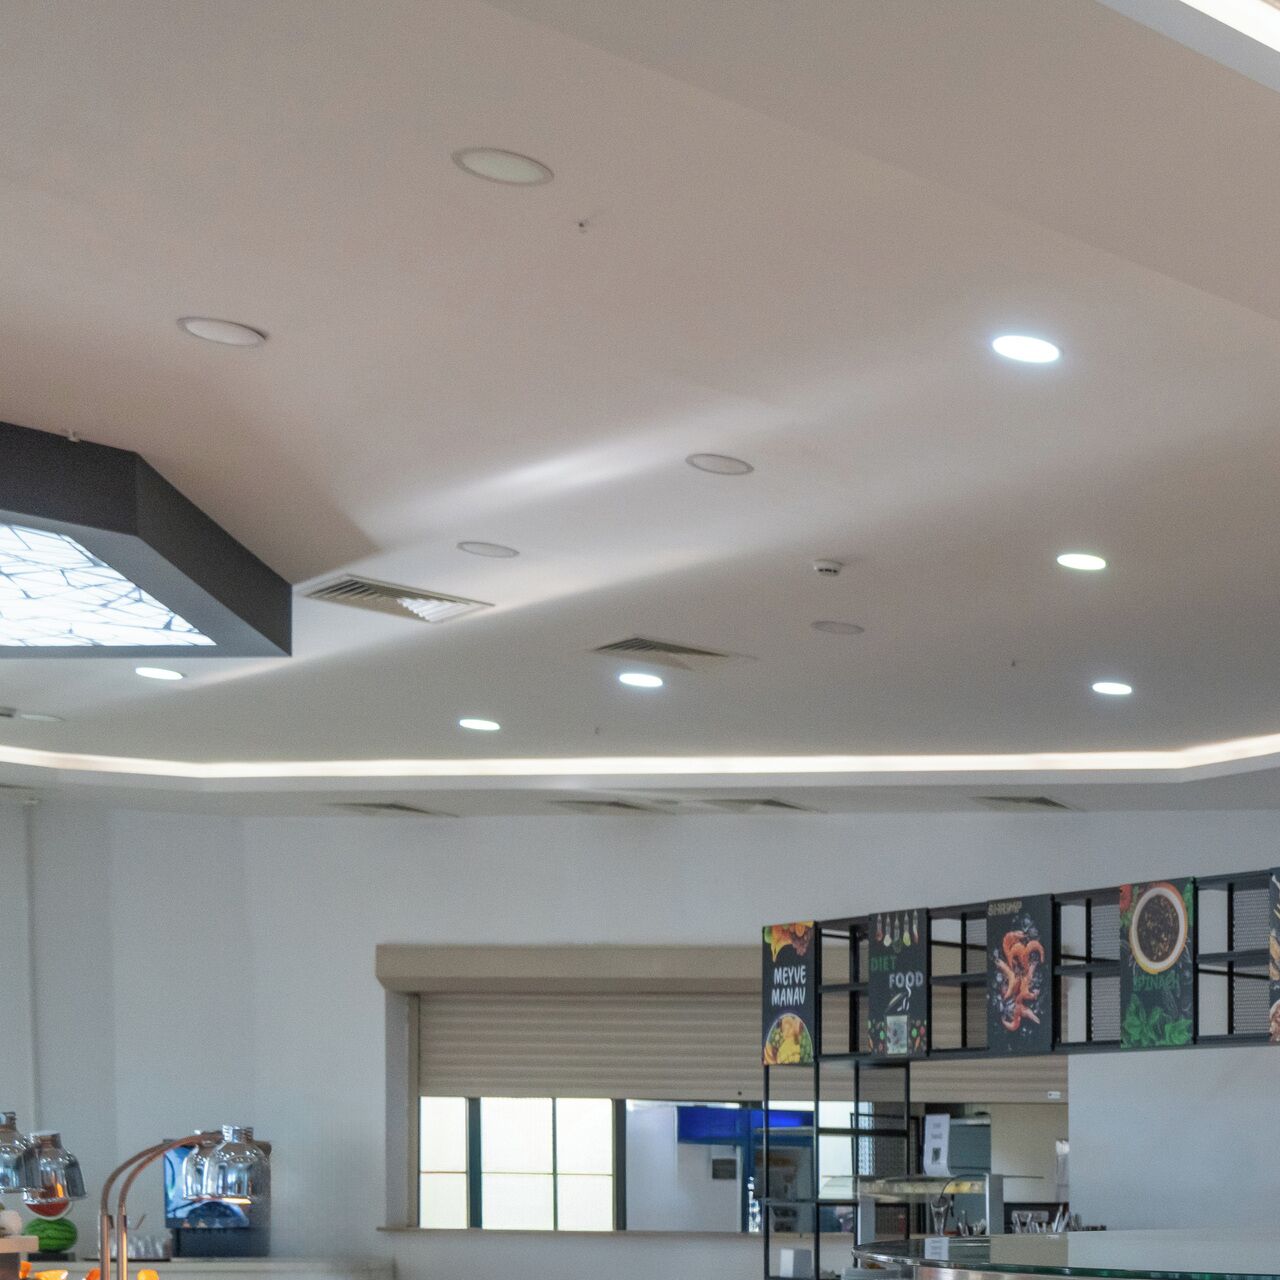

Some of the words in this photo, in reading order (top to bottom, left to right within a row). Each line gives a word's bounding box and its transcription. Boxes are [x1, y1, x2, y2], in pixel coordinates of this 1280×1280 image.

[871, 955, 897, 971] DIET
[774, 965, 806, 985] MEYVE
[889, 971, 924, 989] FOOD
[771, 987, 806, 1007] MANAV
